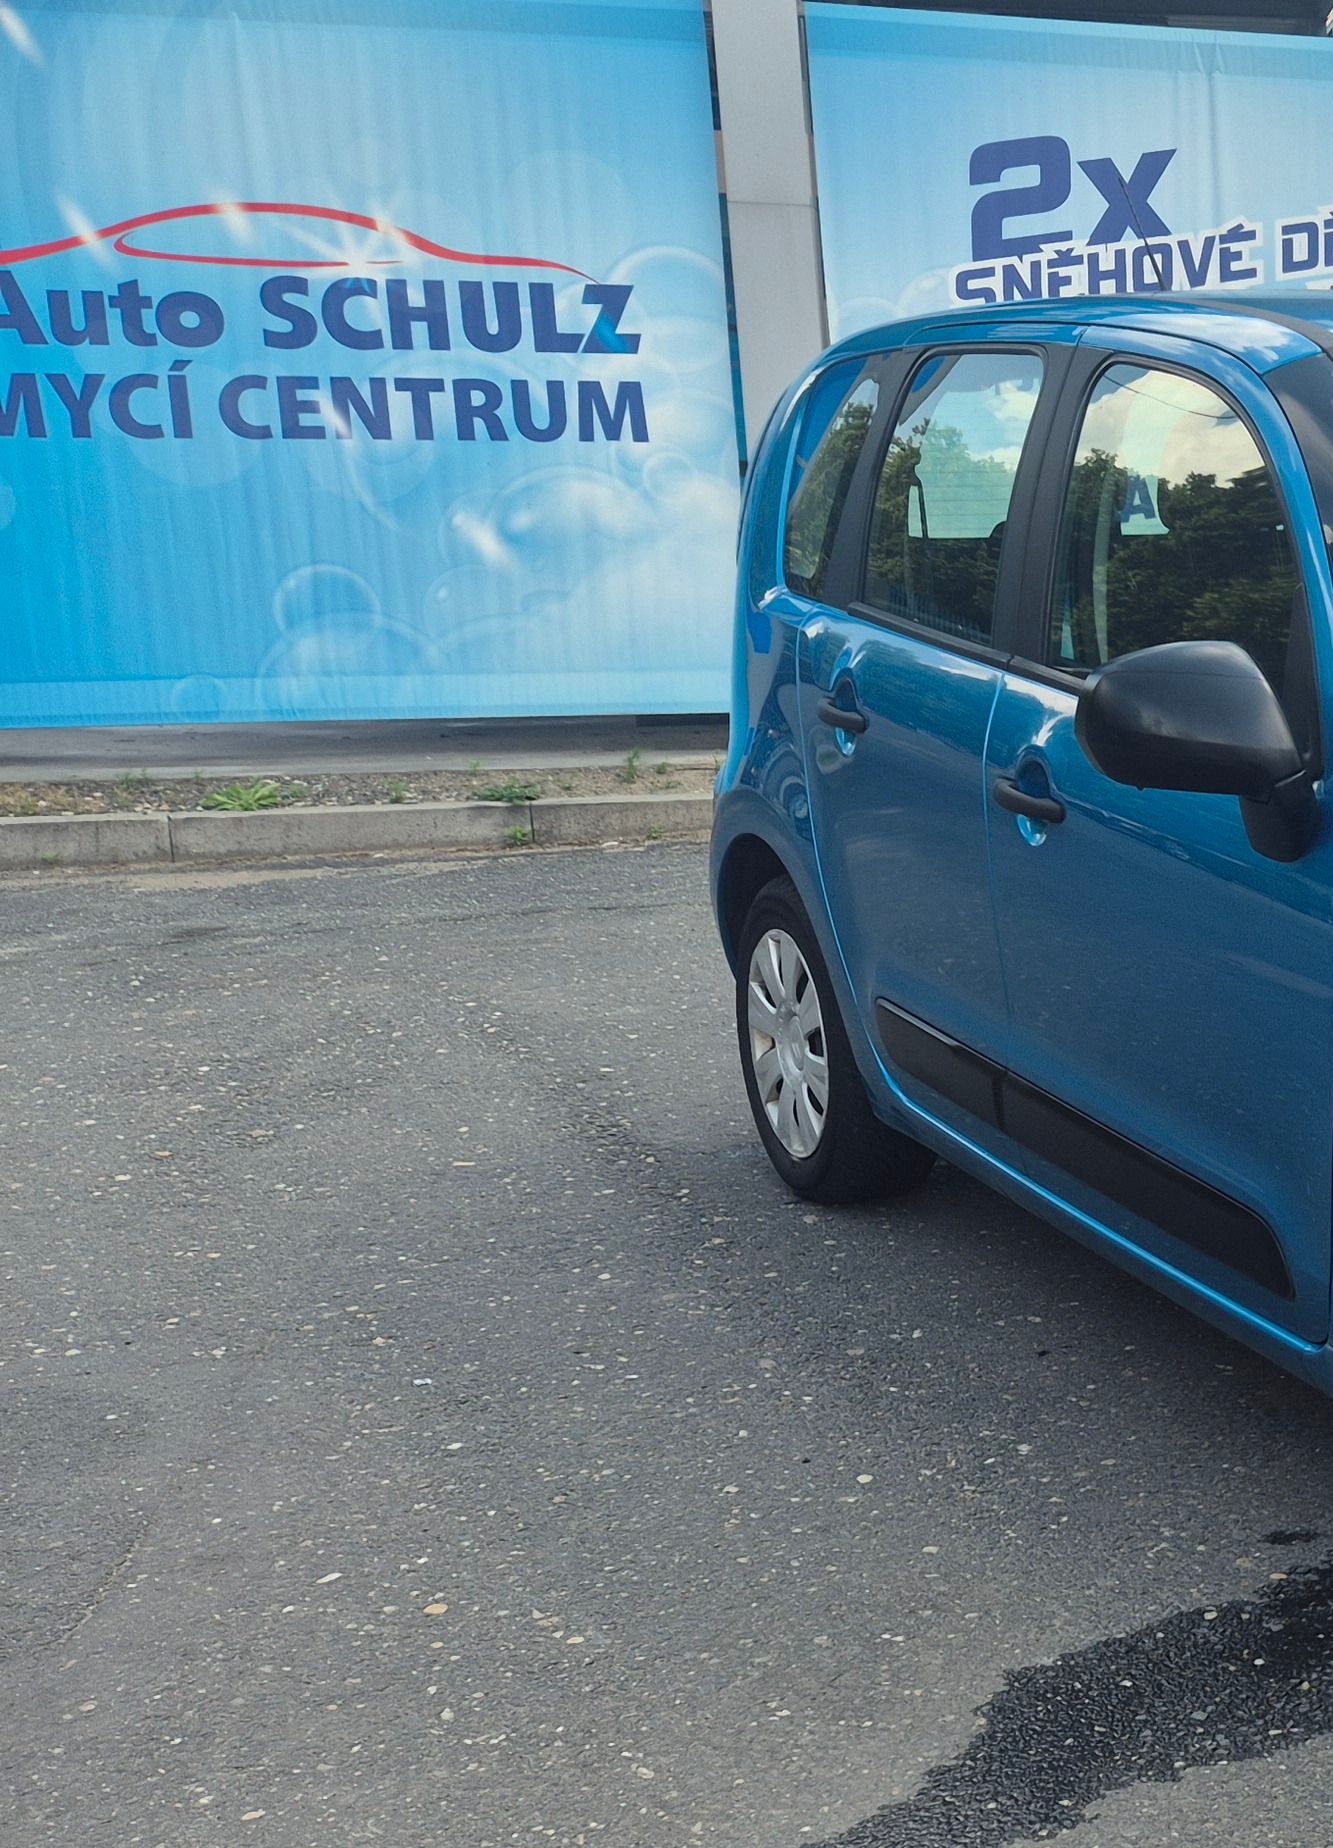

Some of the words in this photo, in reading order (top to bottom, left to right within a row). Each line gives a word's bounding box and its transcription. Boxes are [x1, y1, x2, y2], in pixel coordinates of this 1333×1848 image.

[968, 135, 1178, 261] 2x
[954, 221, 1259, 304] SNĚHOVÉ
[0, 270, 225, 347] Auto
[259, 275, 641, 354] SCHULZ
[0, 359, 193, 440] MYCÍ
[218, 375, 650, 443] CENTRUM
